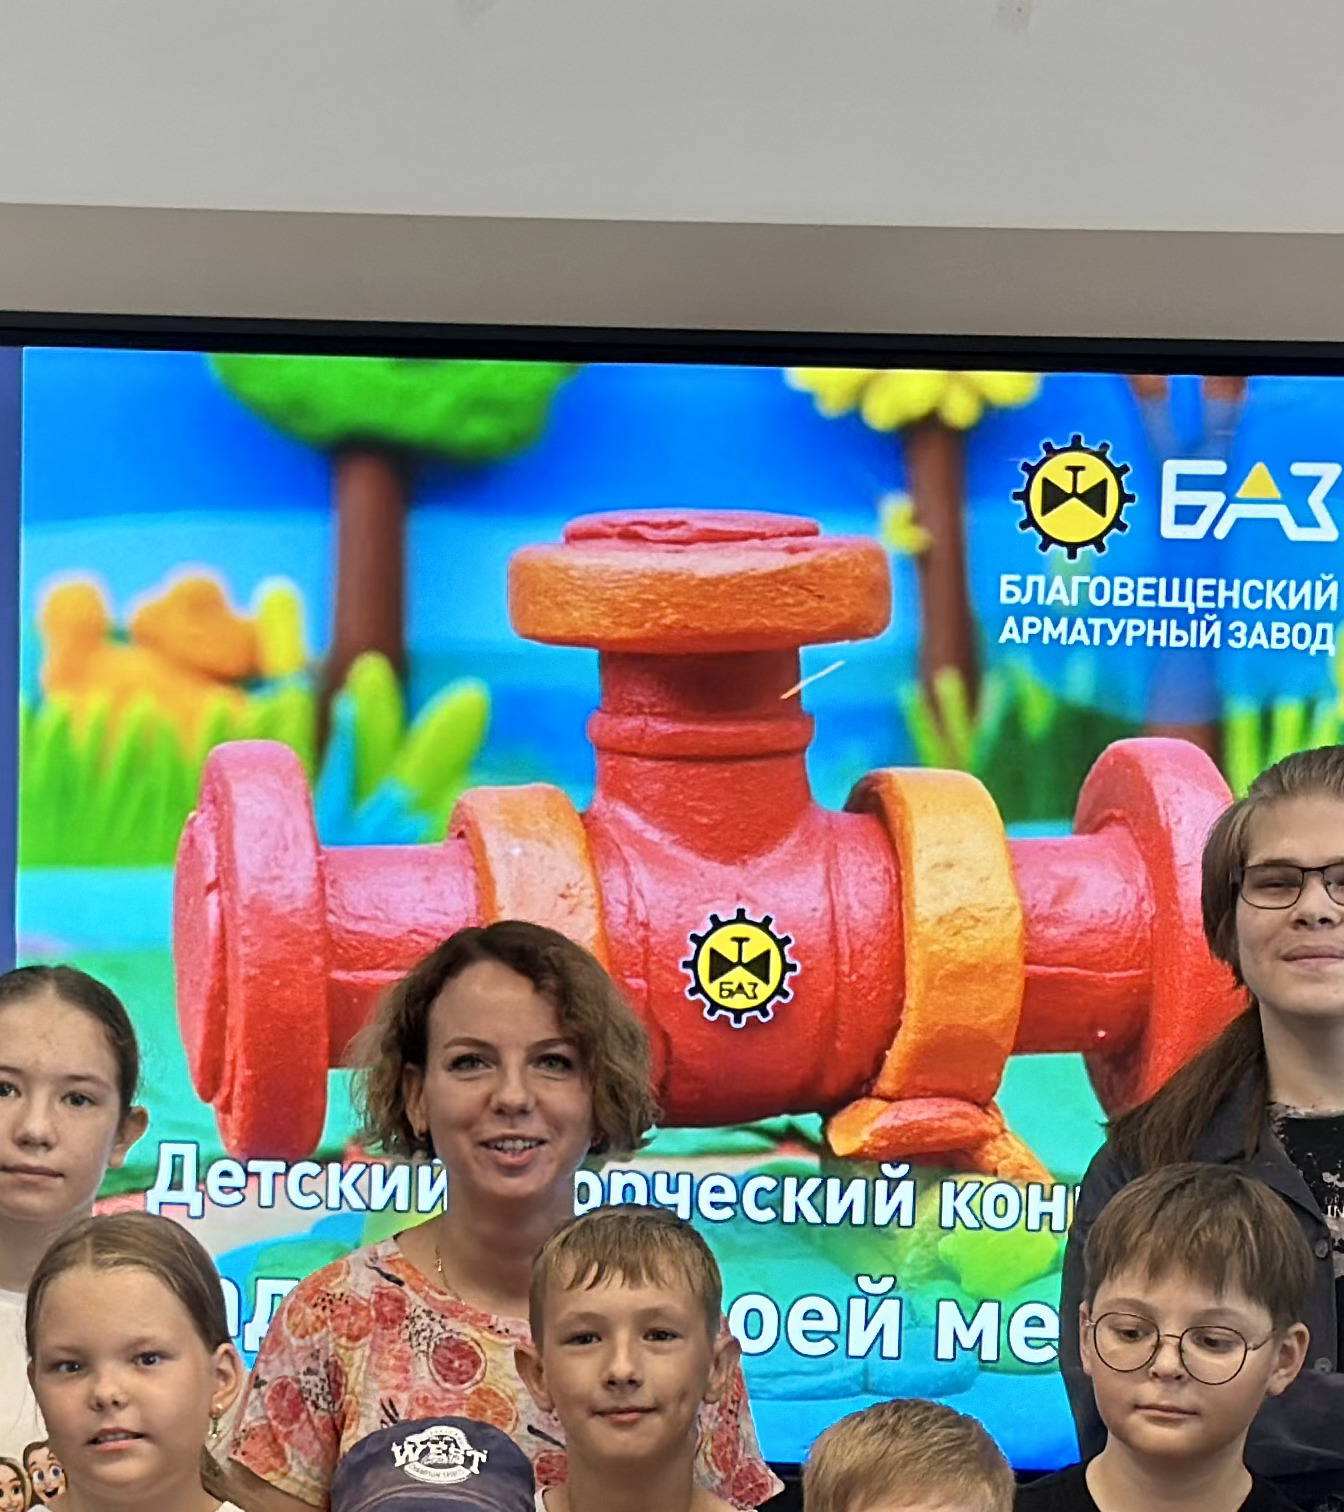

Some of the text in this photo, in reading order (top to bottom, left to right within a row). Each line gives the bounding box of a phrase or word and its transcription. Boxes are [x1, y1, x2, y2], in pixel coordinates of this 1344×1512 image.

[1160, 459, 1343, 542] БАЗ
[999, 573, 1339, 614] БЛАГОВЕЩЕНСКИЙ
[998, 614, 1336, 657] АРМАТУРНЫЙ ЗАВОД
[718, 981, 759, 1000] БАЗ
[146, 1141, 1081, 1232] Детский орческий кон
[730, 1274, 1060, 1364] оей ме
[391, 1440, 489, 1475] WEST
